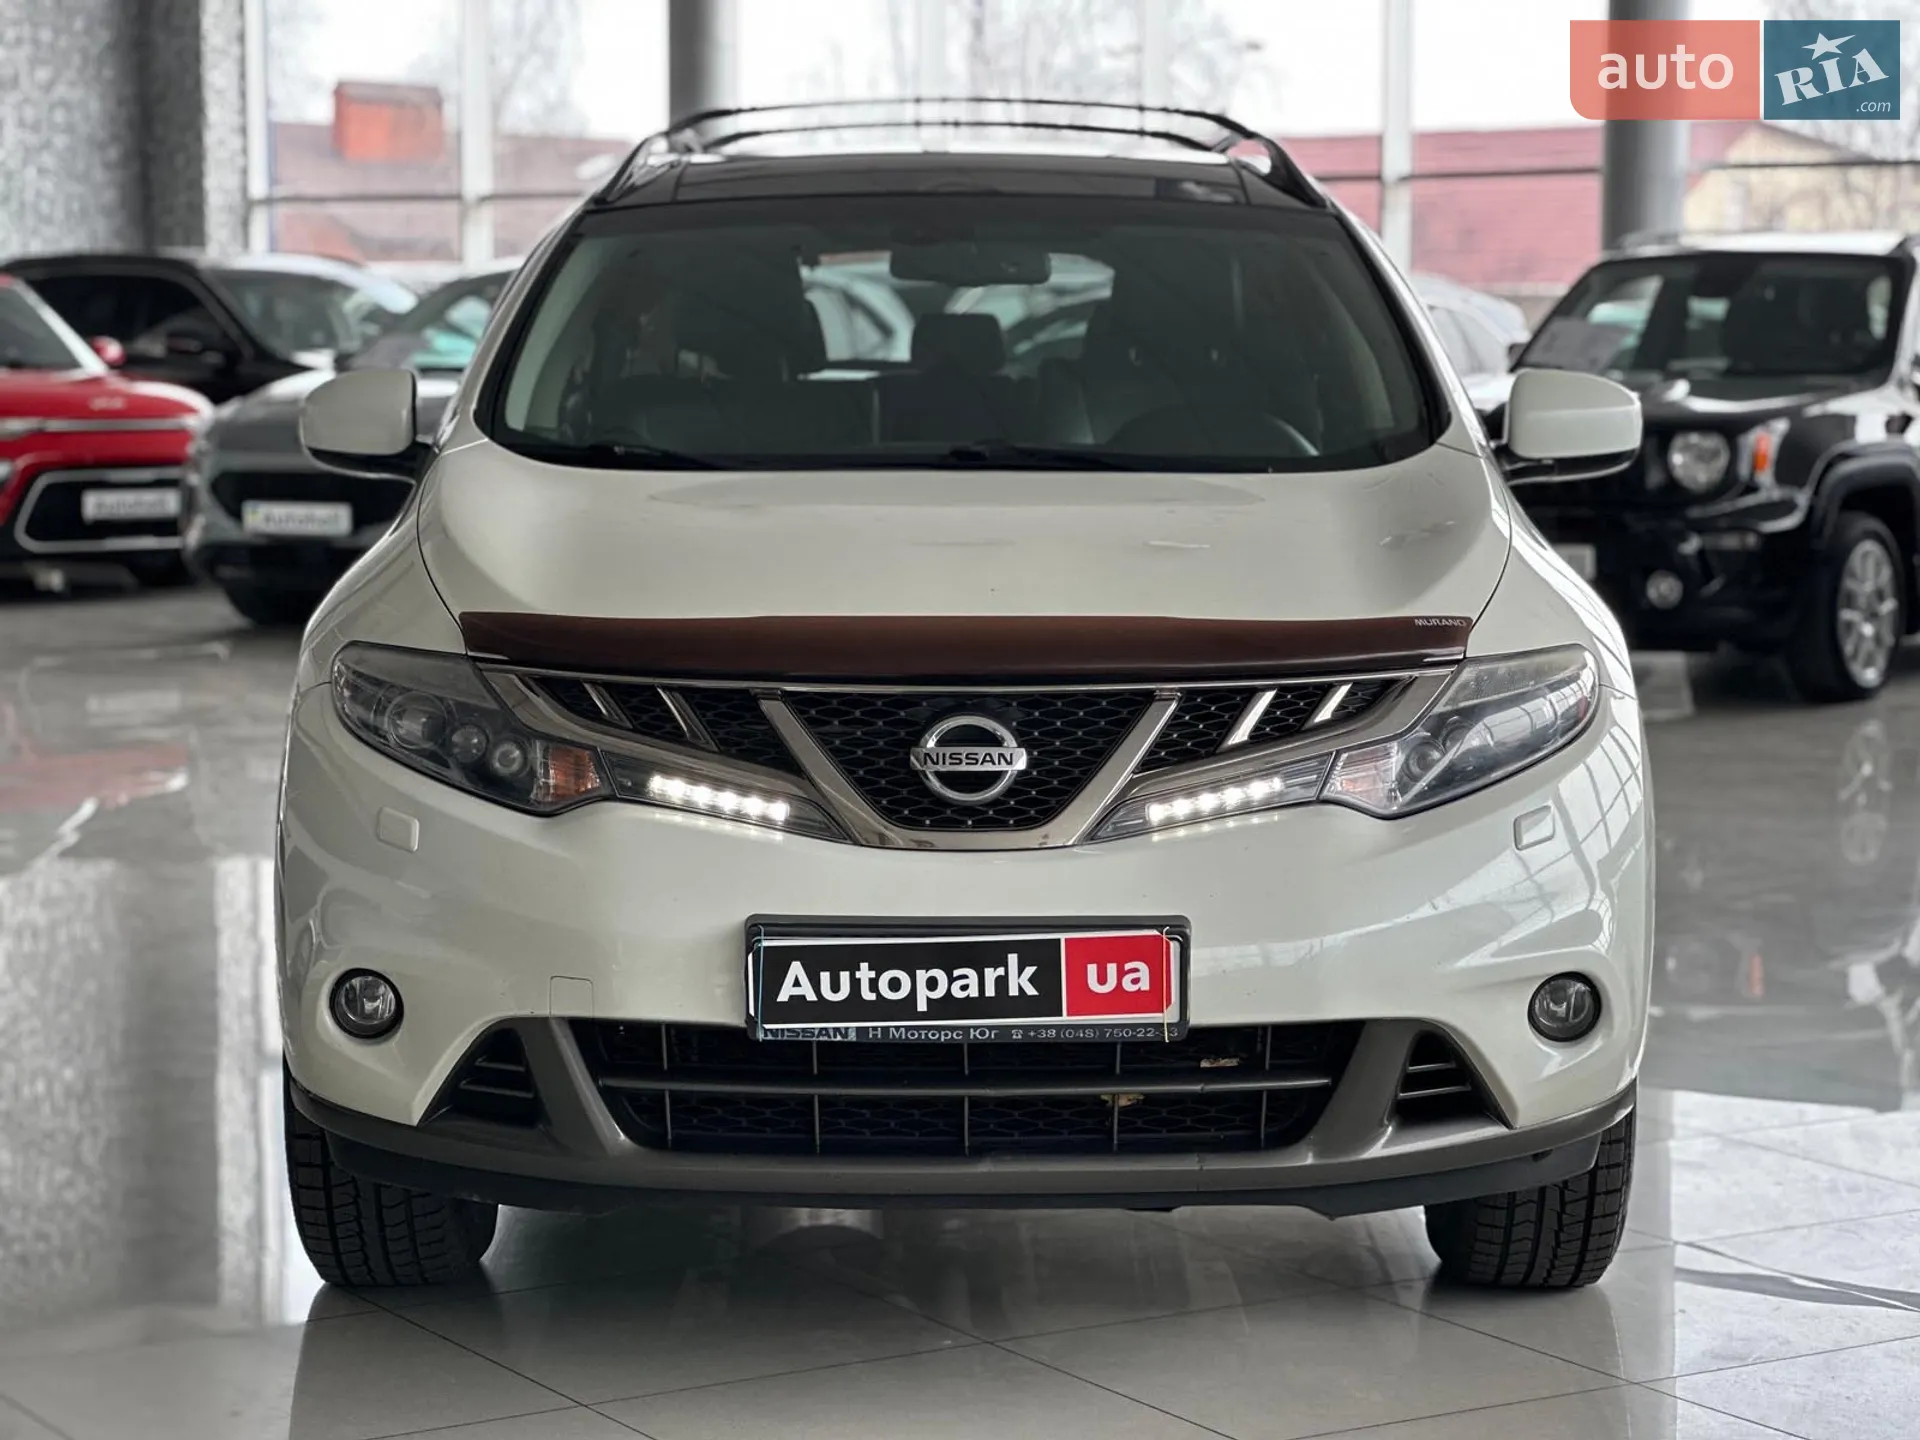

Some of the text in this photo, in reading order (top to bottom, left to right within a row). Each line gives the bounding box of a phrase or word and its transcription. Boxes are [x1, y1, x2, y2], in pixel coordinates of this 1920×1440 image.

[1414, 618, 1467, 627] MURANO
[923, 752, 1013, 766] NISSAN
[776, 953, 1151, 1011] Autopark ua
[763, 1028, 849, 1040] NISSAN
[889, 1027, 964, 1041] Моторс
[970, 1028, 999, 1040] Юг
[1027, 1028, 1057, 1039] +38
